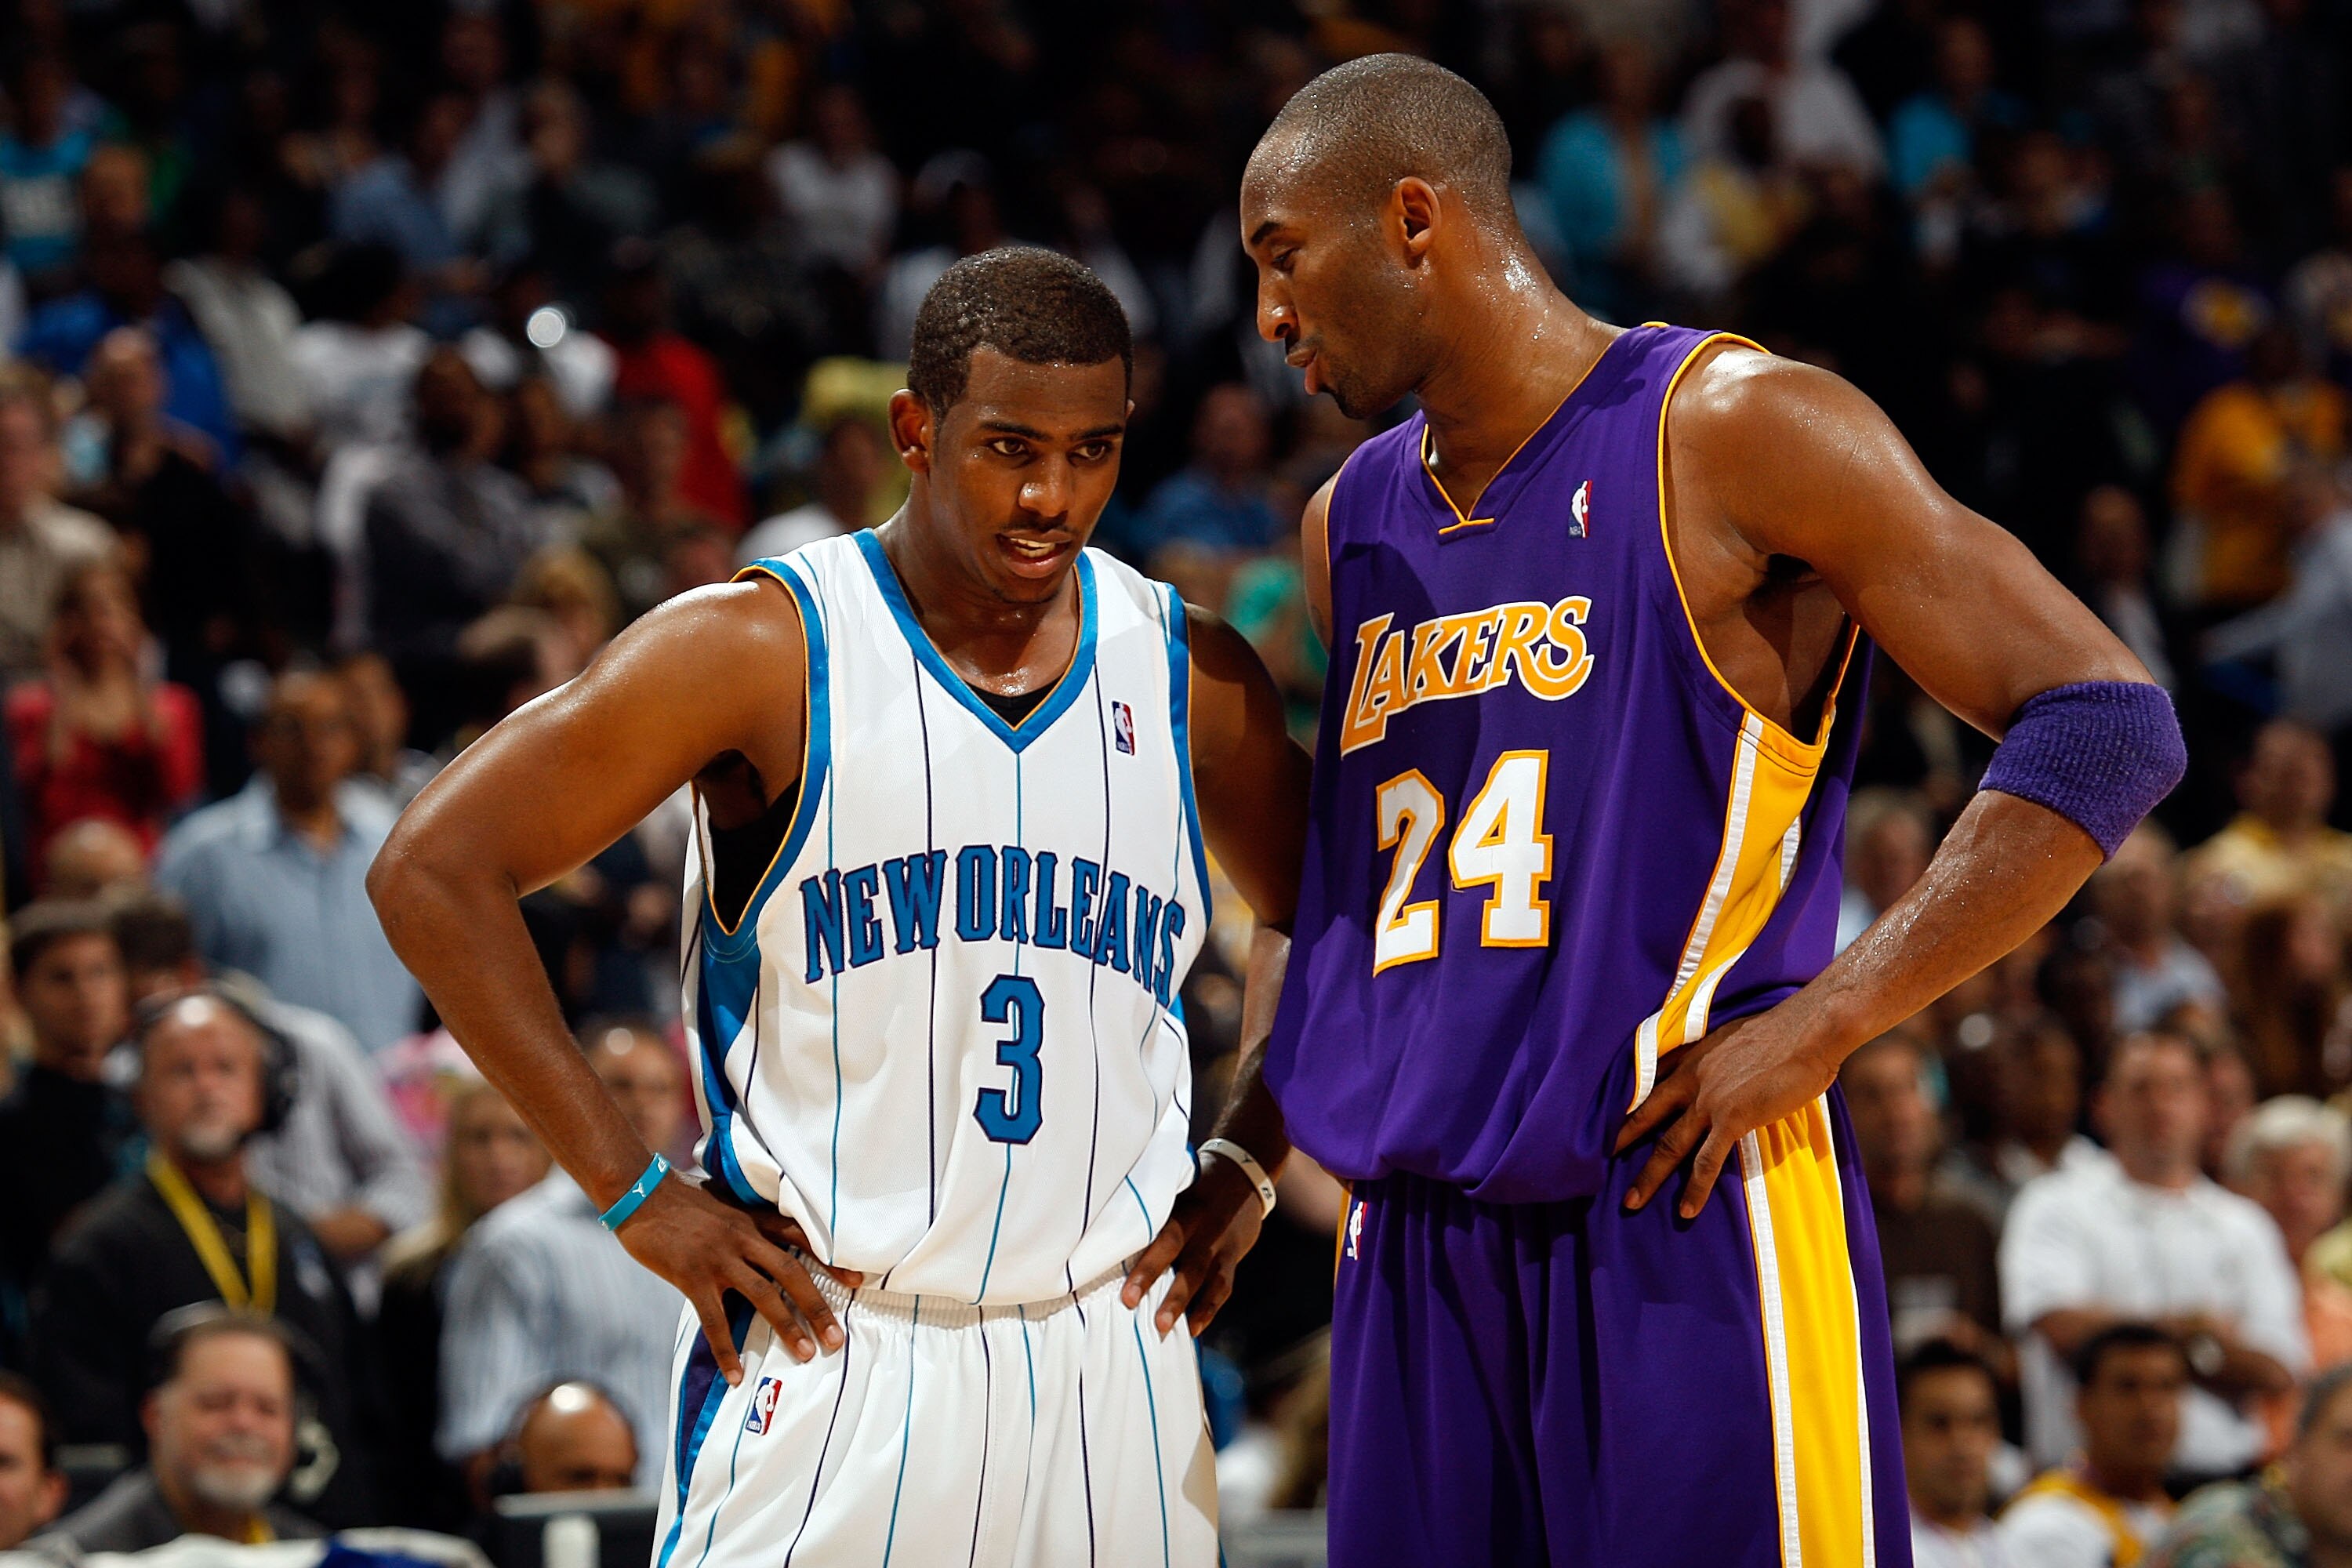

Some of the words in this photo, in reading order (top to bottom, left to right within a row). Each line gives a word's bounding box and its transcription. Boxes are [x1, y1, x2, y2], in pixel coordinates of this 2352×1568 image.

[1340, 595, 1595, 760] LAKERS
[799, 849, 947, 985] NEW
[954, 844, 1185, 1009] ORLEANS
[1373, 749, 1553, 978] 24
[973, 974, 1045, 1145] 3
